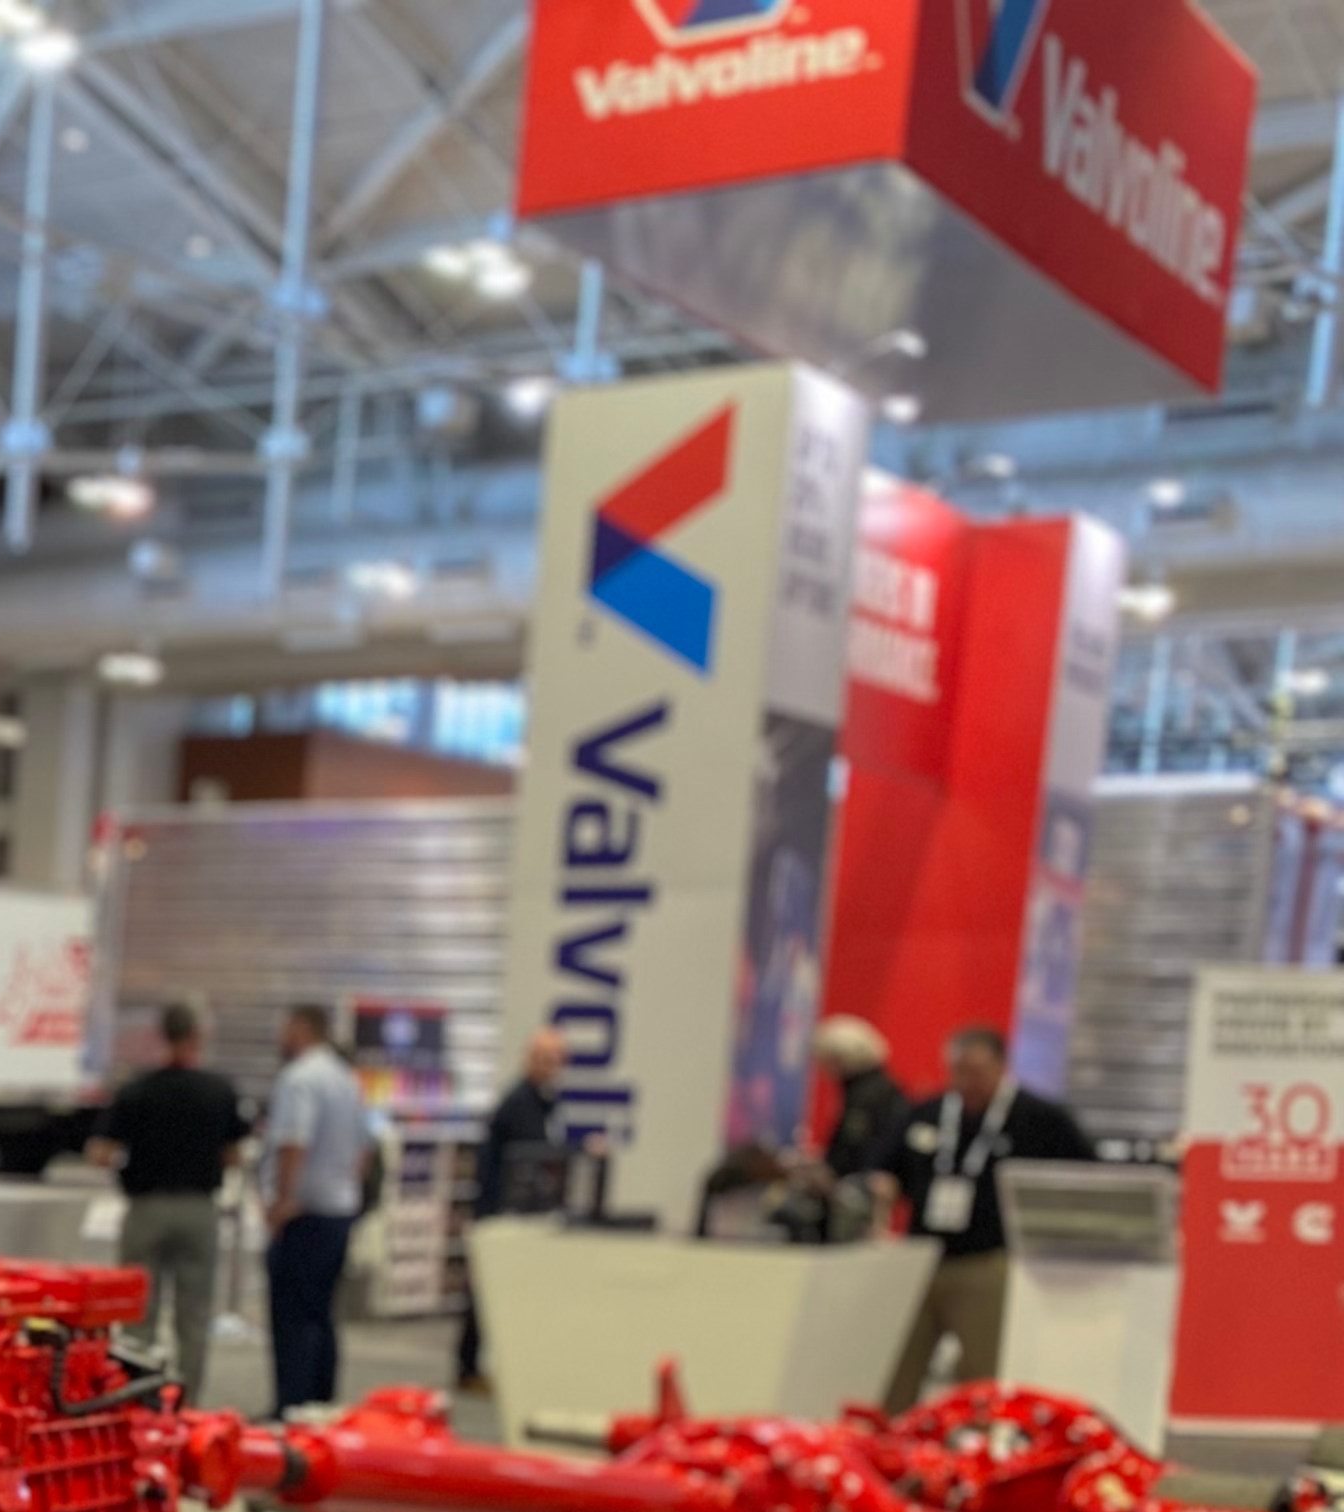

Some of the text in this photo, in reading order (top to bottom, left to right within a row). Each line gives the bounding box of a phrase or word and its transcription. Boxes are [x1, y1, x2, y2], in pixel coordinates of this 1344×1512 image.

[572, 24, 869, 122] Valvoline
[1042, 32, 1226, 301] Valvoline
[1239, 1081, 1331, 1150] 30
